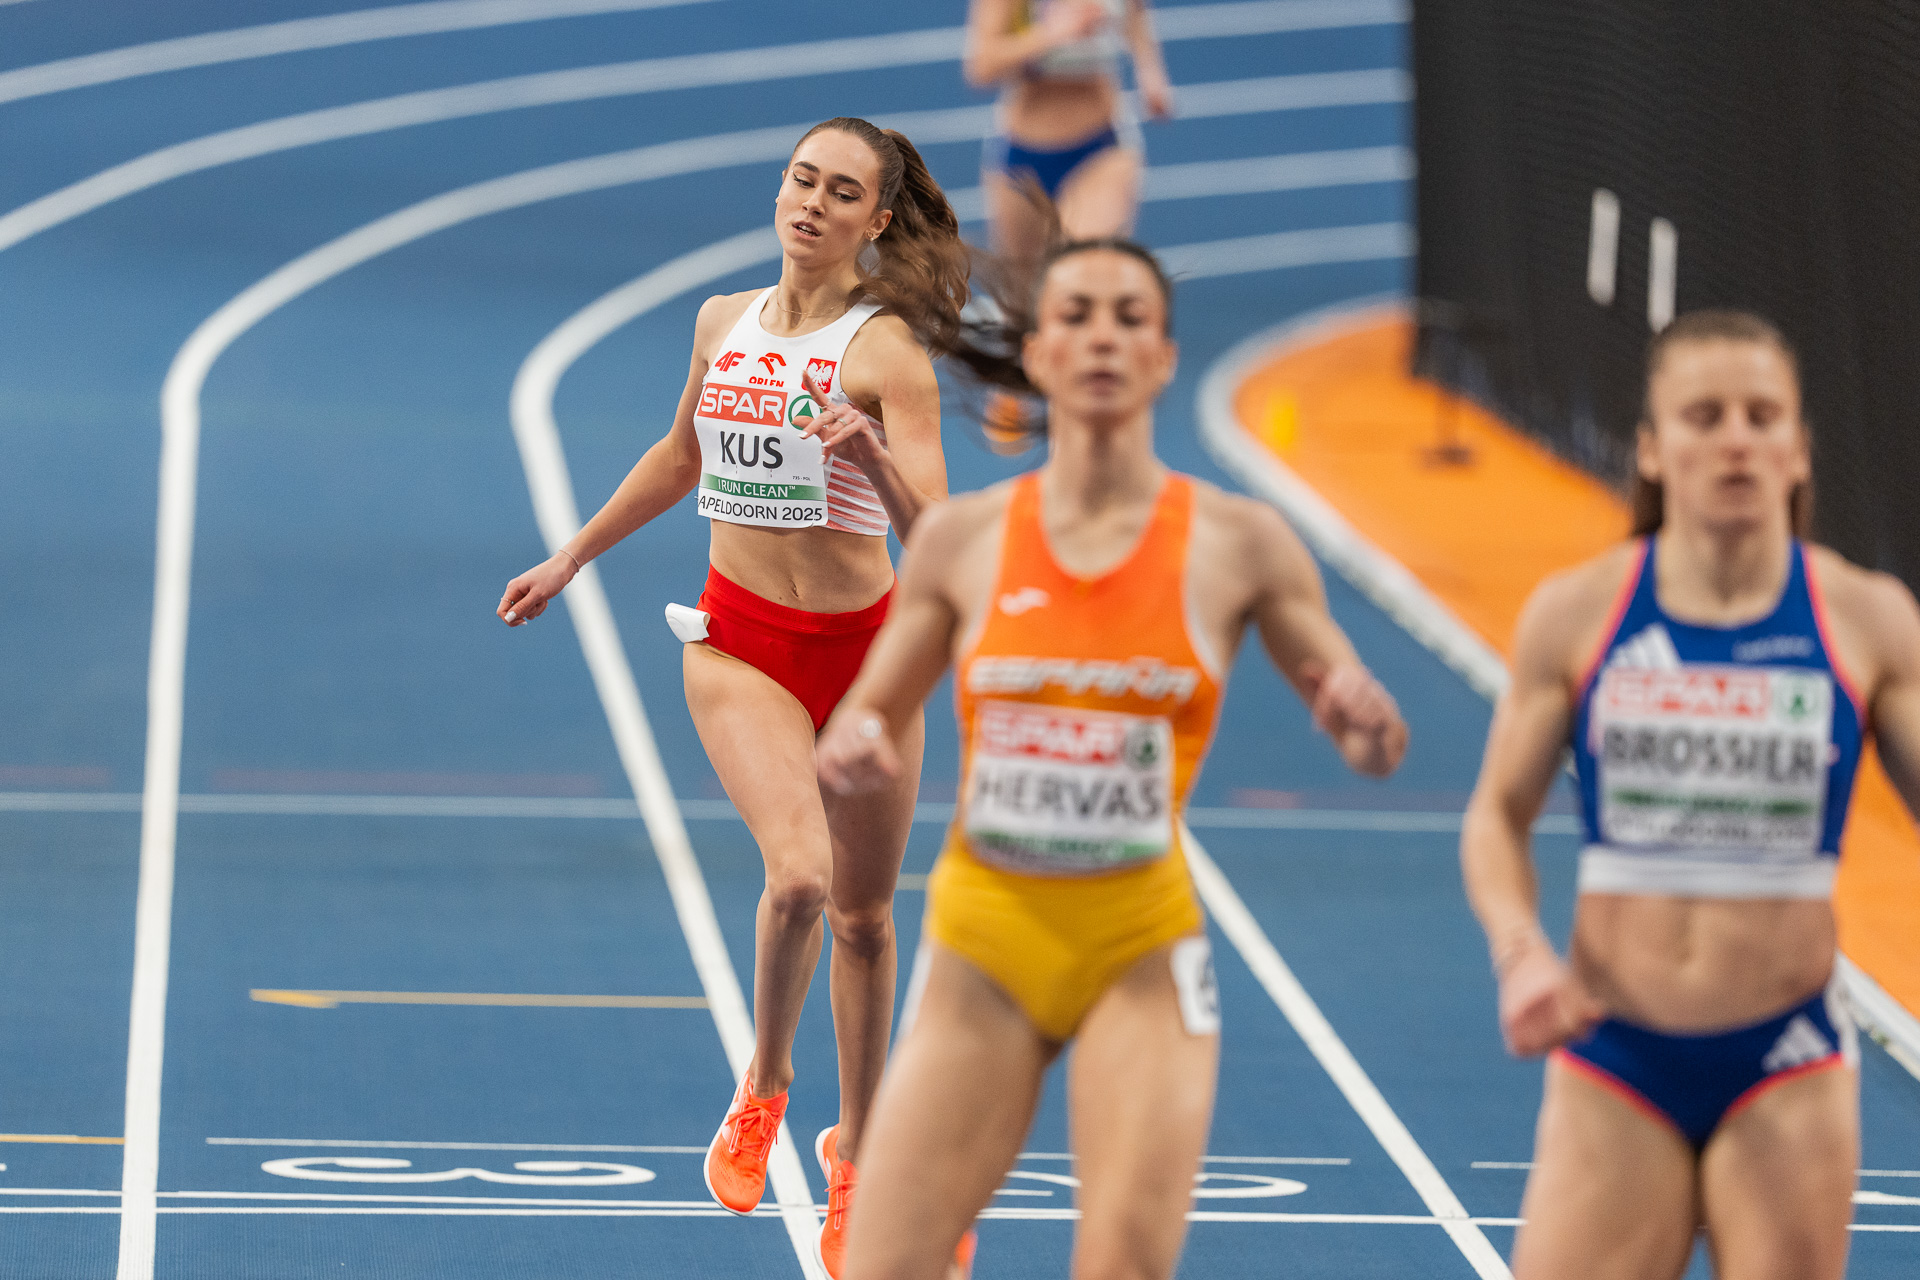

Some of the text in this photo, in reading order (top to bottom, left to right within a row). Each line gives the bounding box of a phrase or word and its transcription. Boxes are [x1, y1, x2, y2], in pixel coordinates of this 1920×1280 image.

[715, 350, 747, 372] 4F
[701, 387, 784, 422] SPAR
[719, 430, 784, 470] KUS
[717, 479, 721, 490] I
[721, 479, 741, 494] RUN
[698, 495, 823, 521] APELDOORN 2025
[974, 765, 1163, 824] HERVAS
